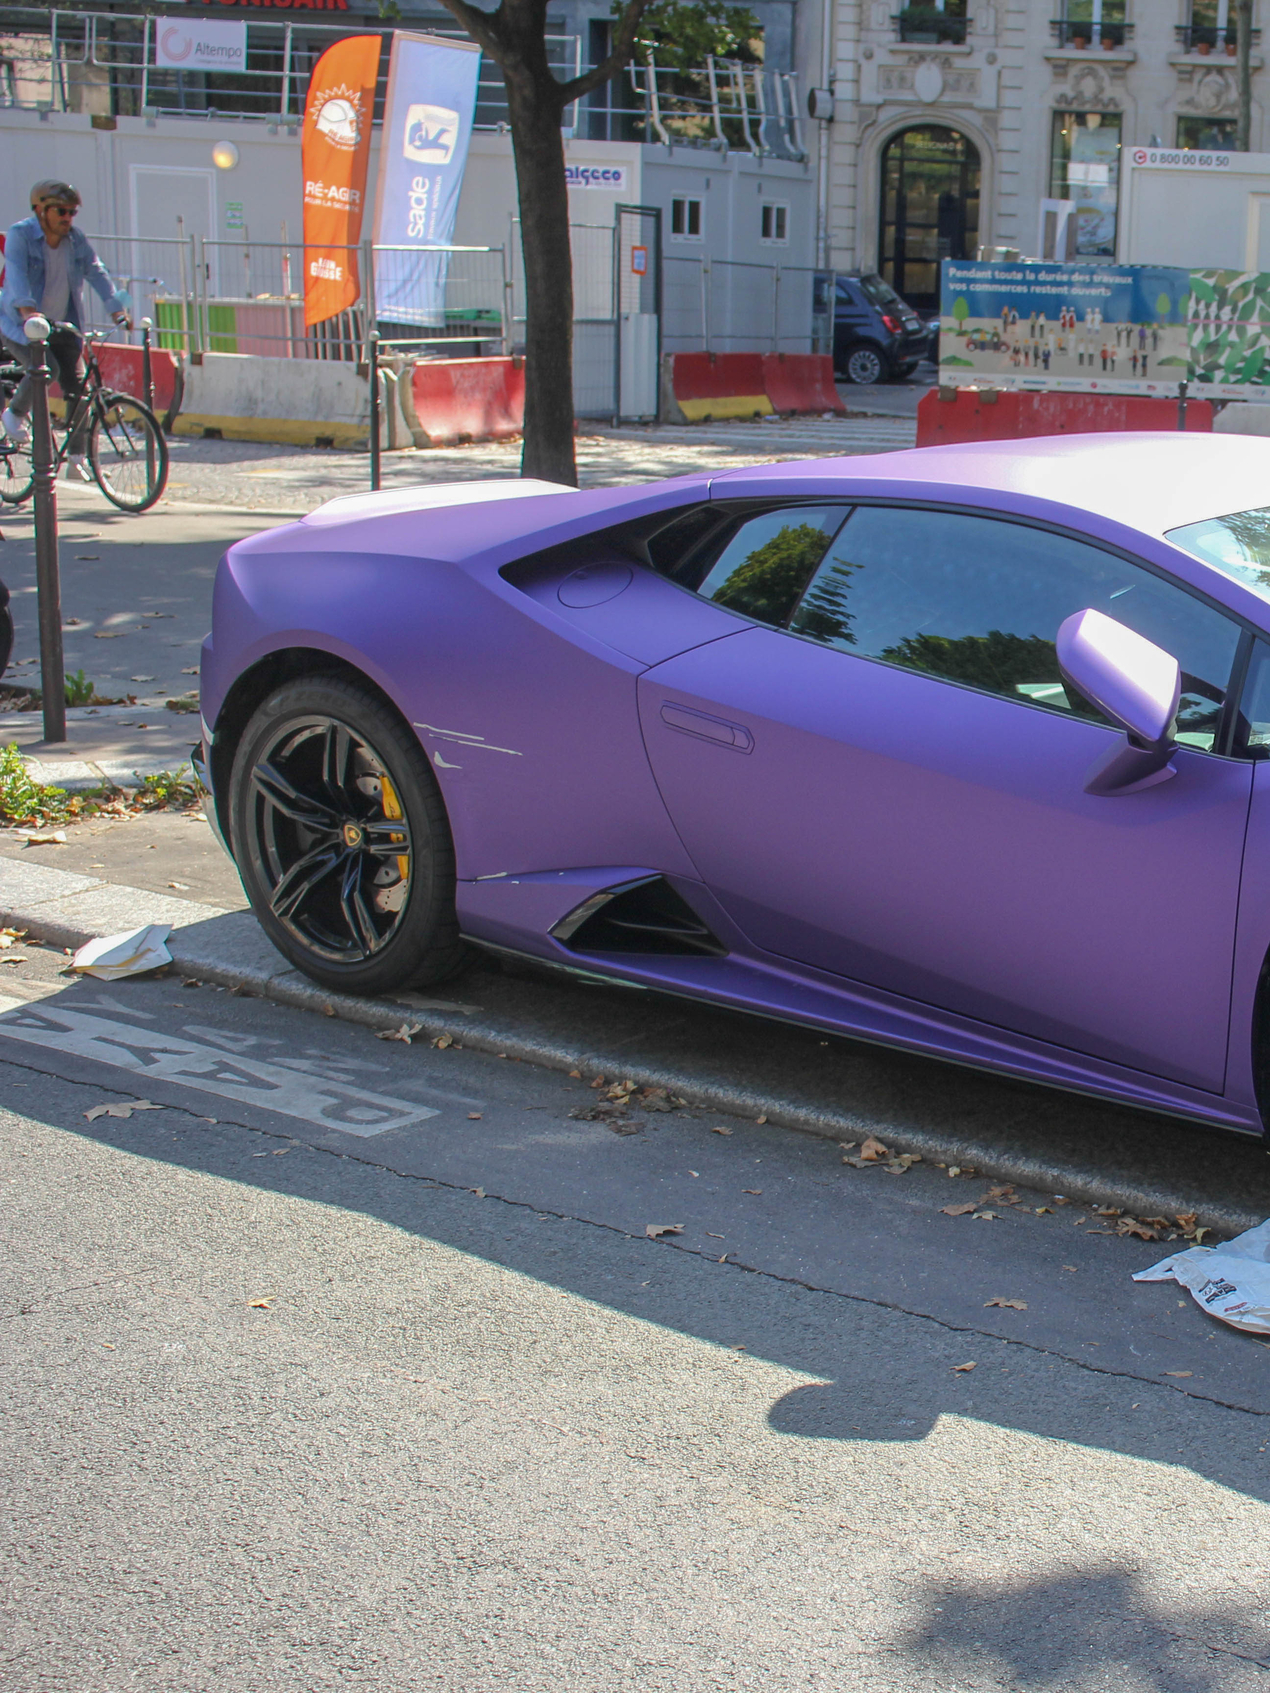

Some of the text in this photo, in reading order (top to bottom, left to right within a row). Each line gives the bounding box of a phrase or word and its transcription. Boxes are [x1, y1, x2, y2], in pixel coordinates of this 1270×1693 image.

[195, 42, 242, 59] Altempo
[1150, 152, 1229, 167] 0 800 00 60 50
[305, 180, 361, 205] RÉ-AGIR
[406, 176, 430, 239] sade
[949, 267, 1133, 285] Pendant toute la durée des travaux
[949, 283, 1112, 297] vos commerces restent ouverts
